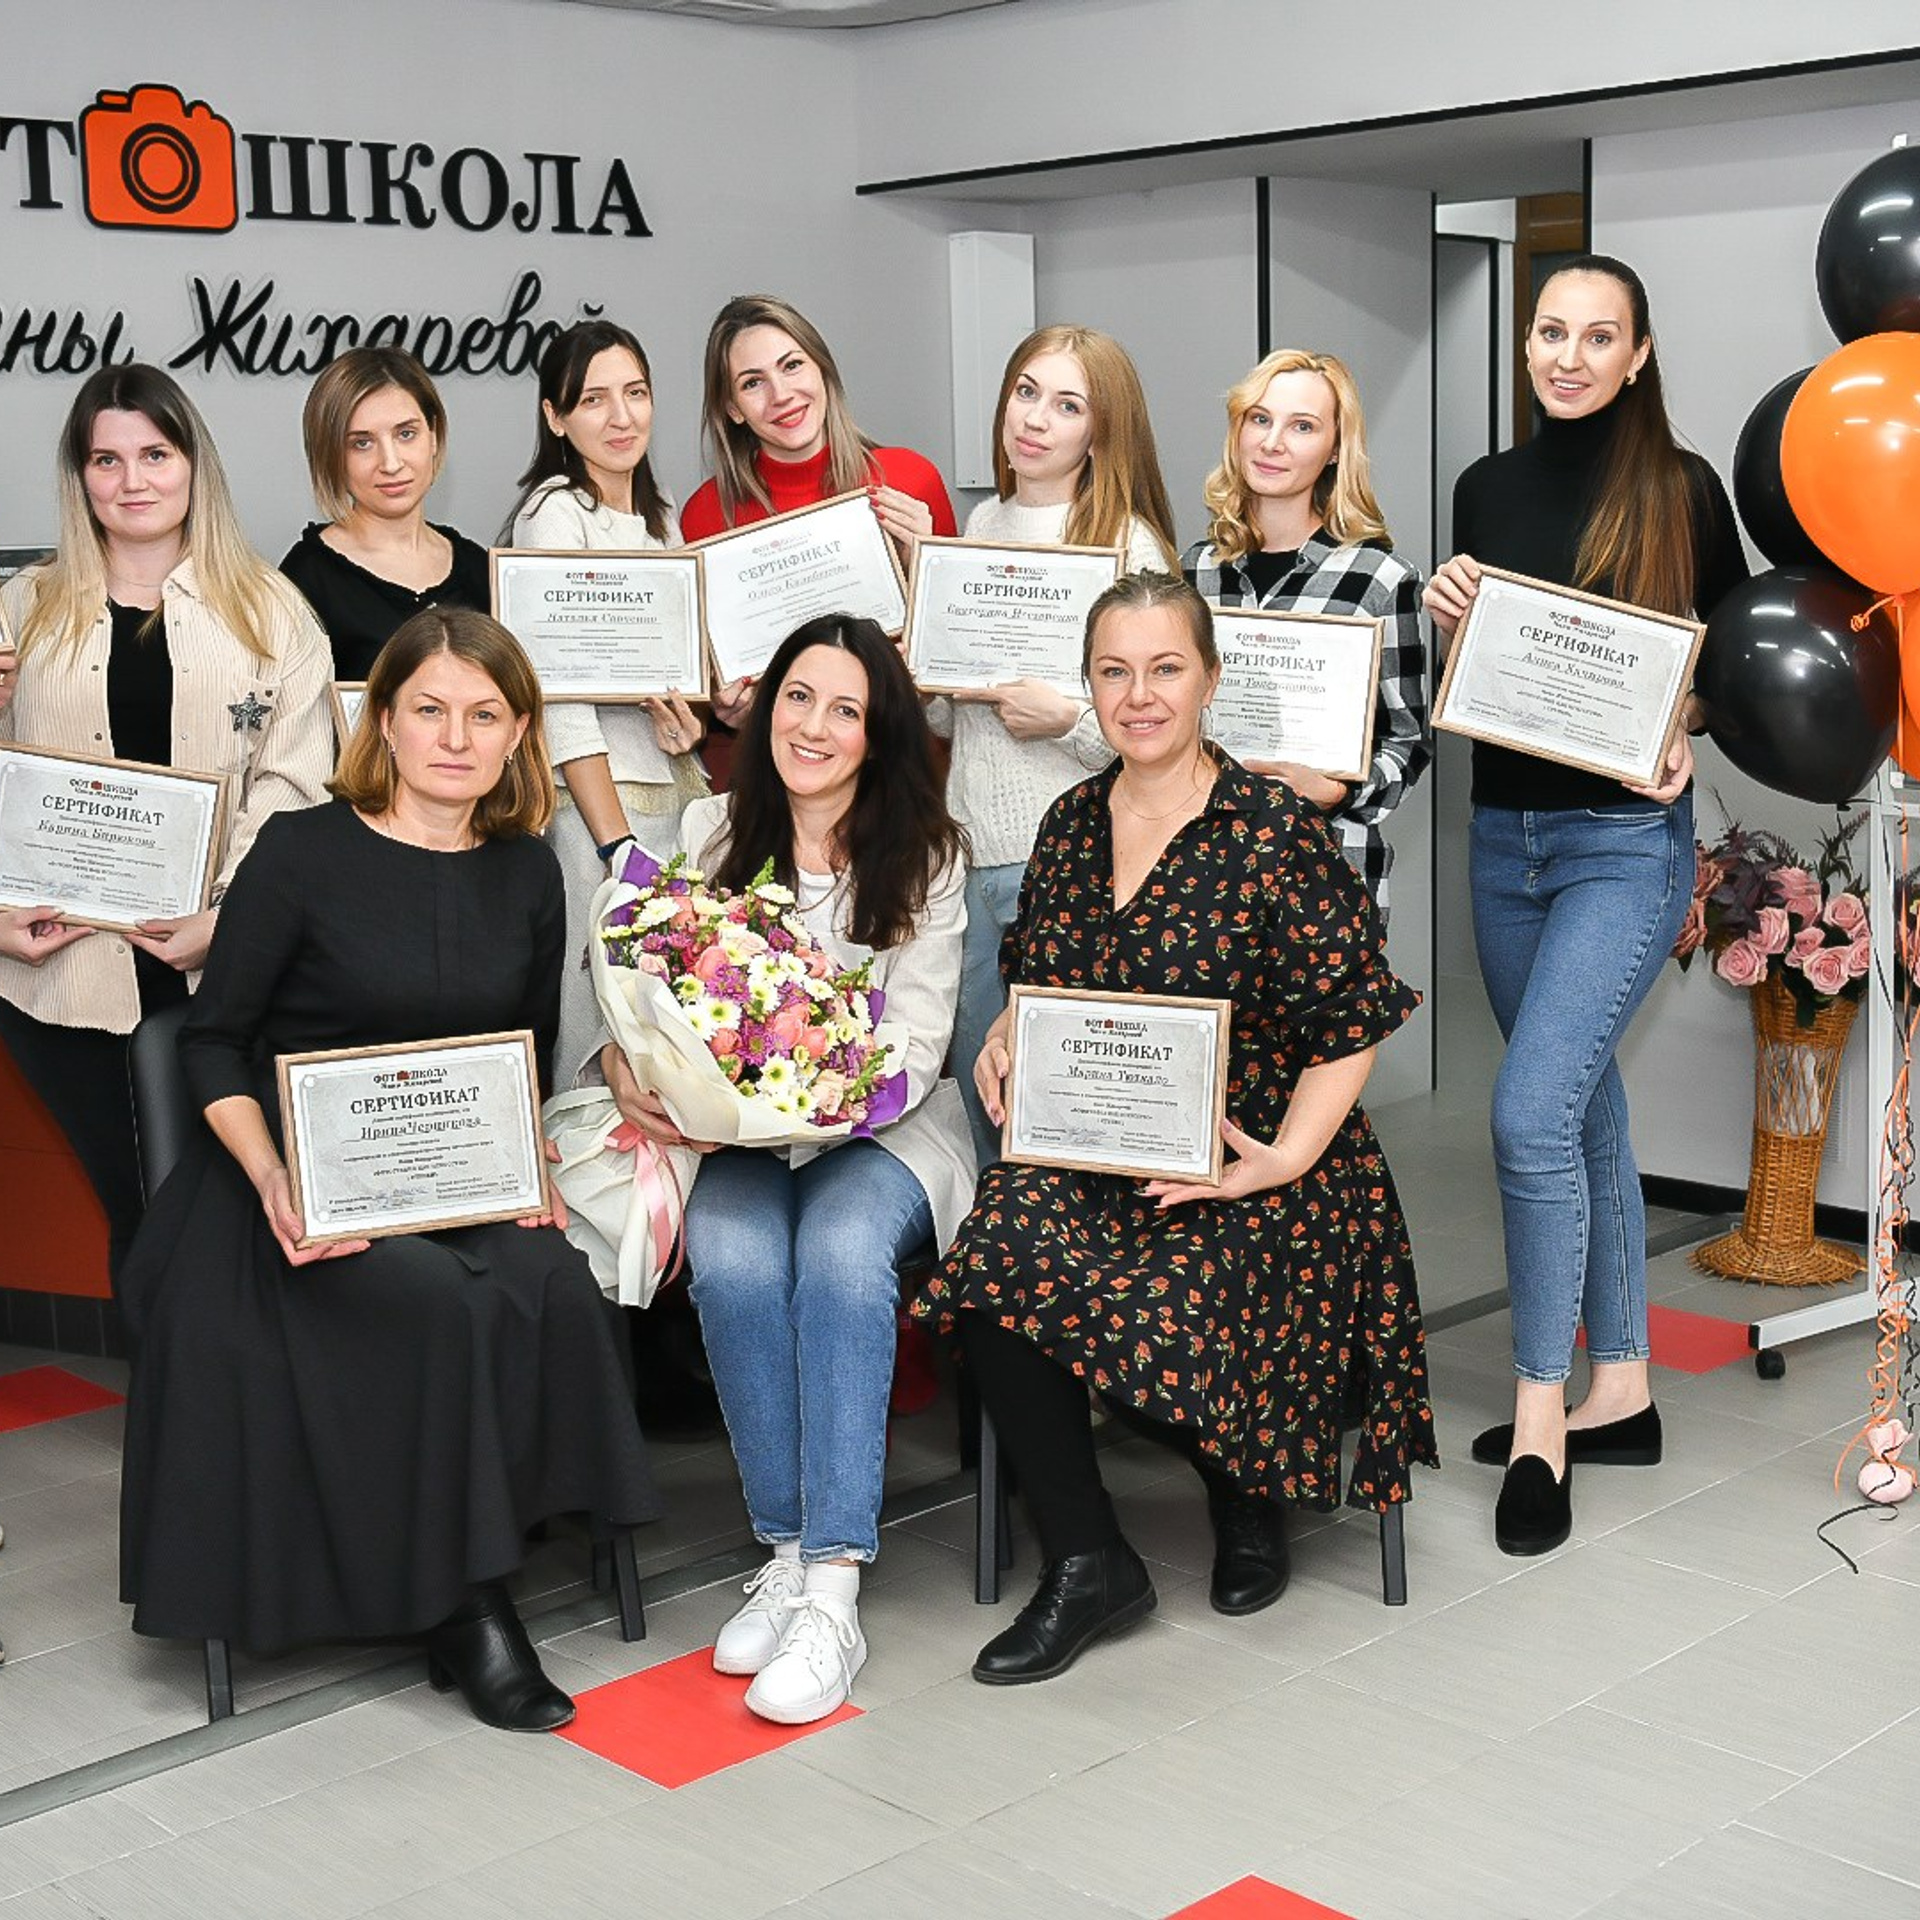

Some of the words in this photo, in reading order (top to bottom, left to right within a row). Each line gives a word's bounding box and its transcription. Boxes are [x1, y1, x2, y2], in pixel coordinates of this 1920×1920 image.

[0, 308, 134, 373] ны
[167, 271, 603, 375] Жихарево
[737, 540, 841, 583] СЕРТИФИКАТ
[544, 590, 654, 604] СЕРТИФИКАТ
[963, 582, 1072, 601] СЕРТИФИКАТ
[1519, 625, 1639, 668] СЕРТИФИКАТ
[1223, 651, 1326, 672] ЕРТИФИКАТ
[42, 794, 165, 826] СЕРТИФИКАТ
[1061, 1038, 1173, 1061] СЕРТИФИКАТ
[350, 1086, 480, 1115] СЕРТИФИКАТ
